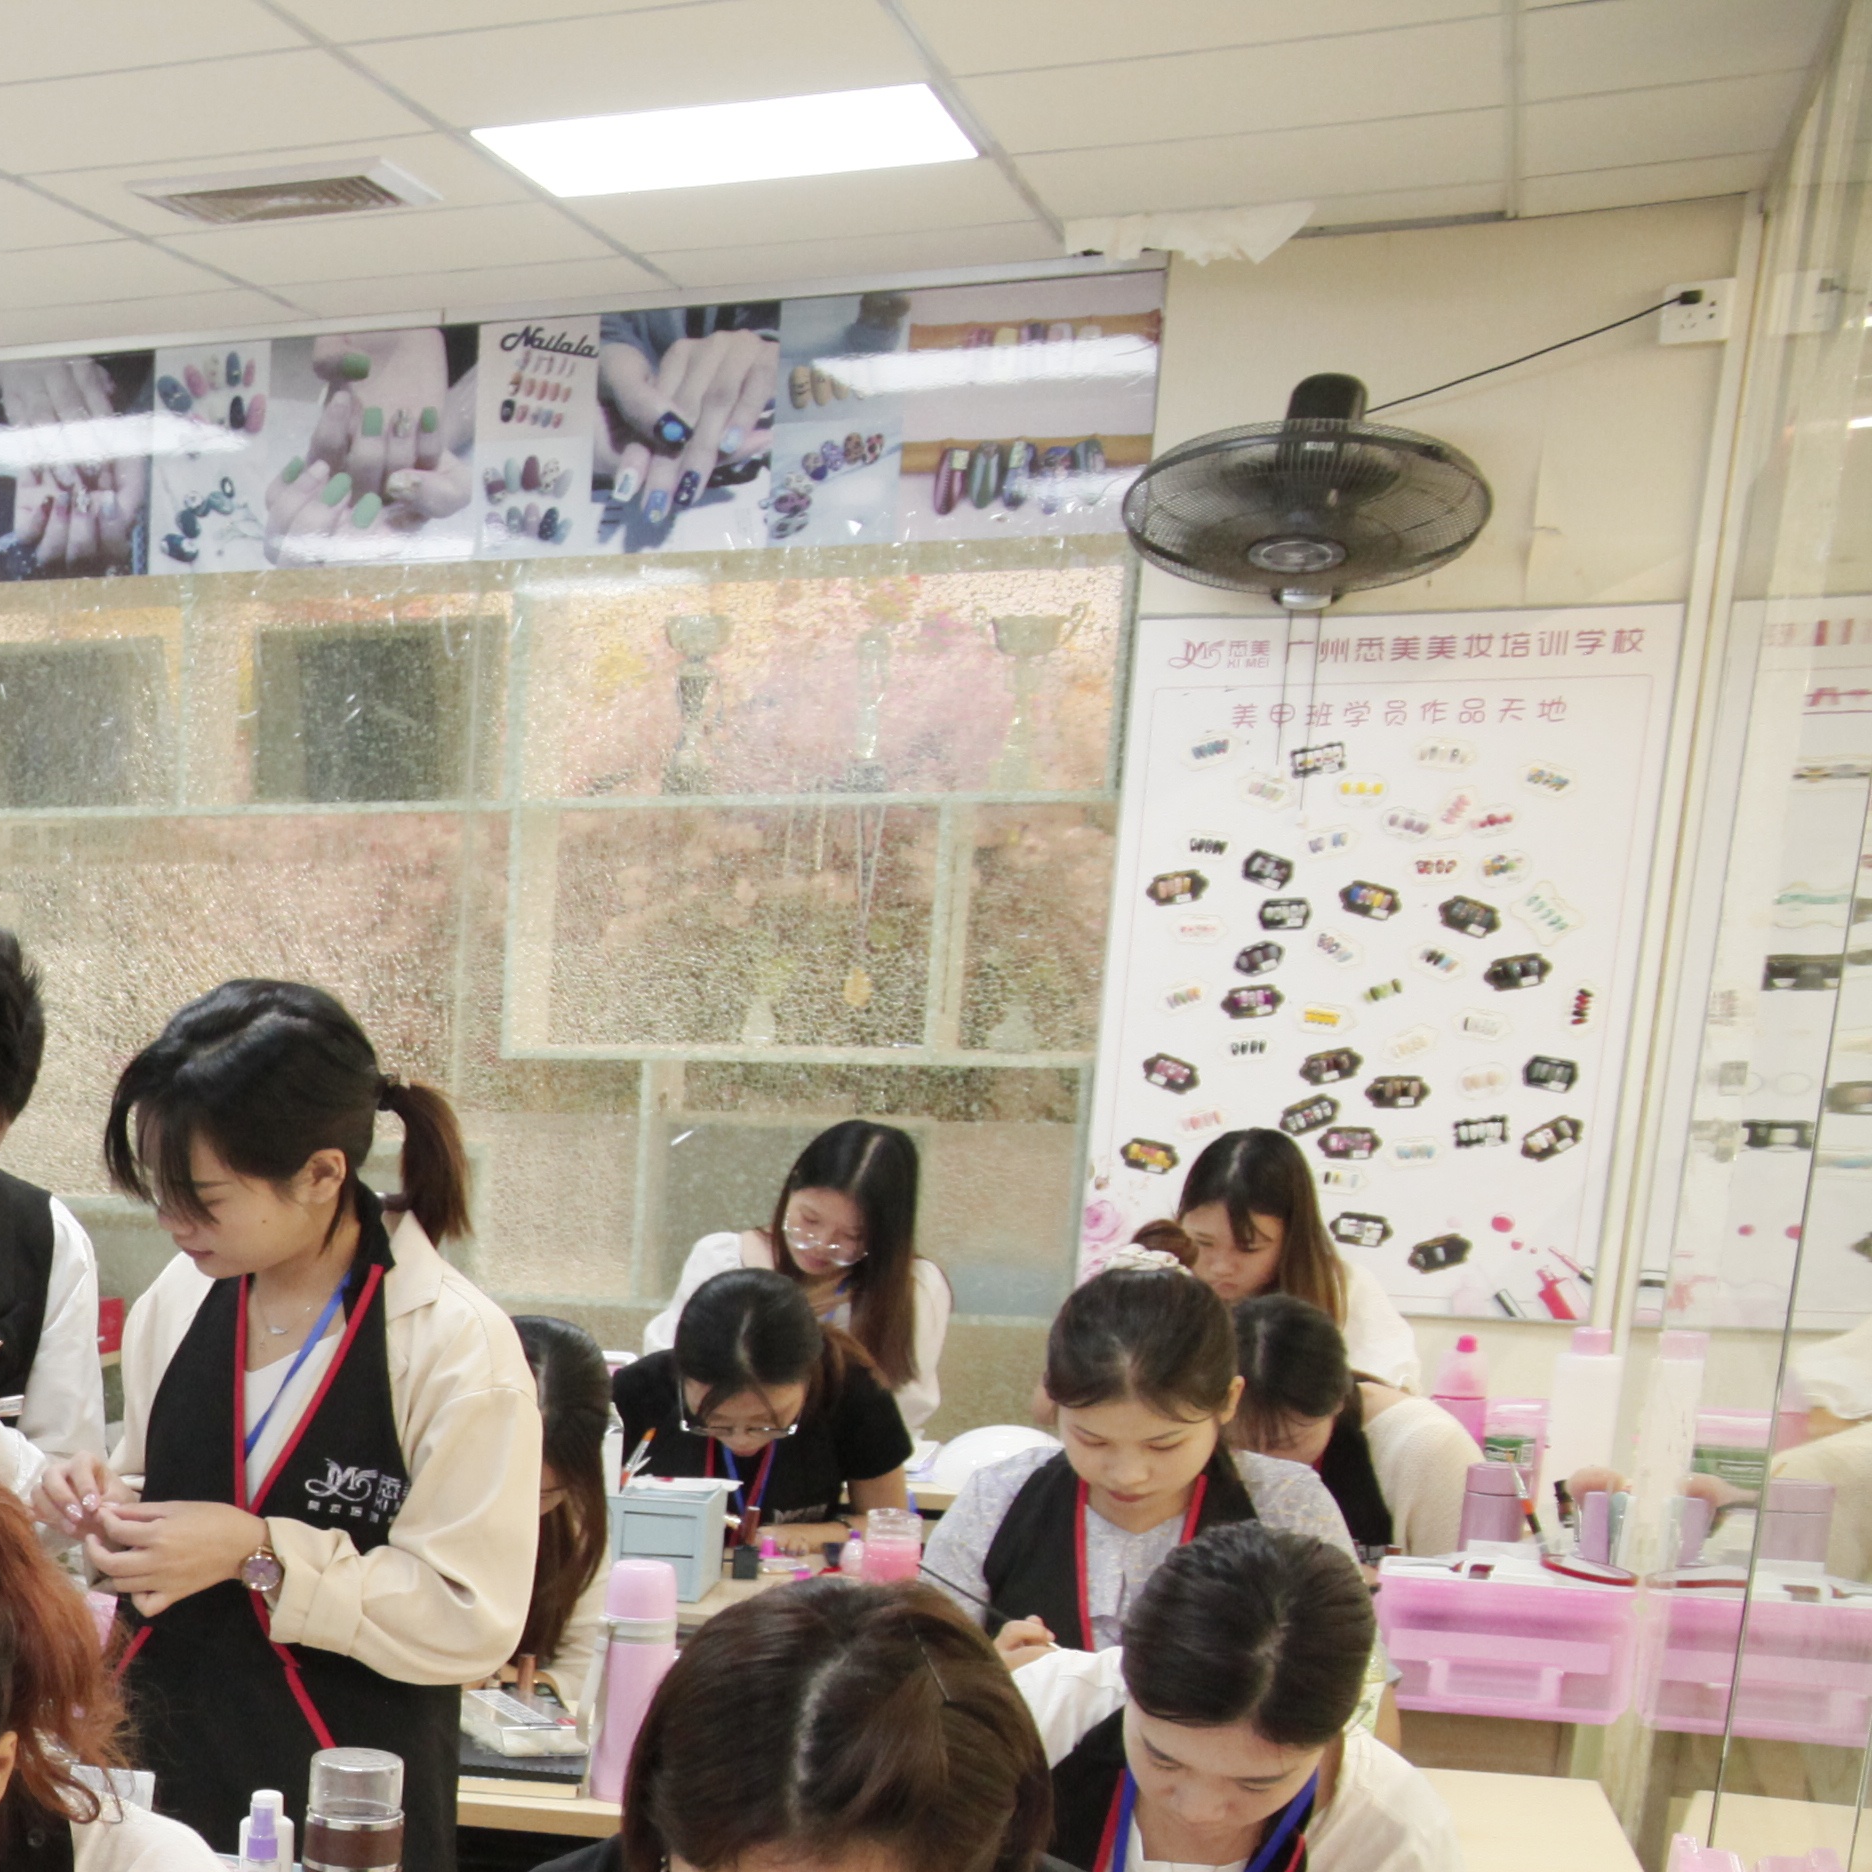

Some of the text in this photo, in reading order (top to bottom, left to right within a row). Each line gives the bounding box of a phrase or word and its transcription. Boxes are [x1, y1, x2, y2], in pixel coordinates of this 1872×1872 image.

[1285, 628, 1646, 664] 广州悉美美妆培训学校
[1231, 695, 1568, 729] 美甲班学员作品天地
